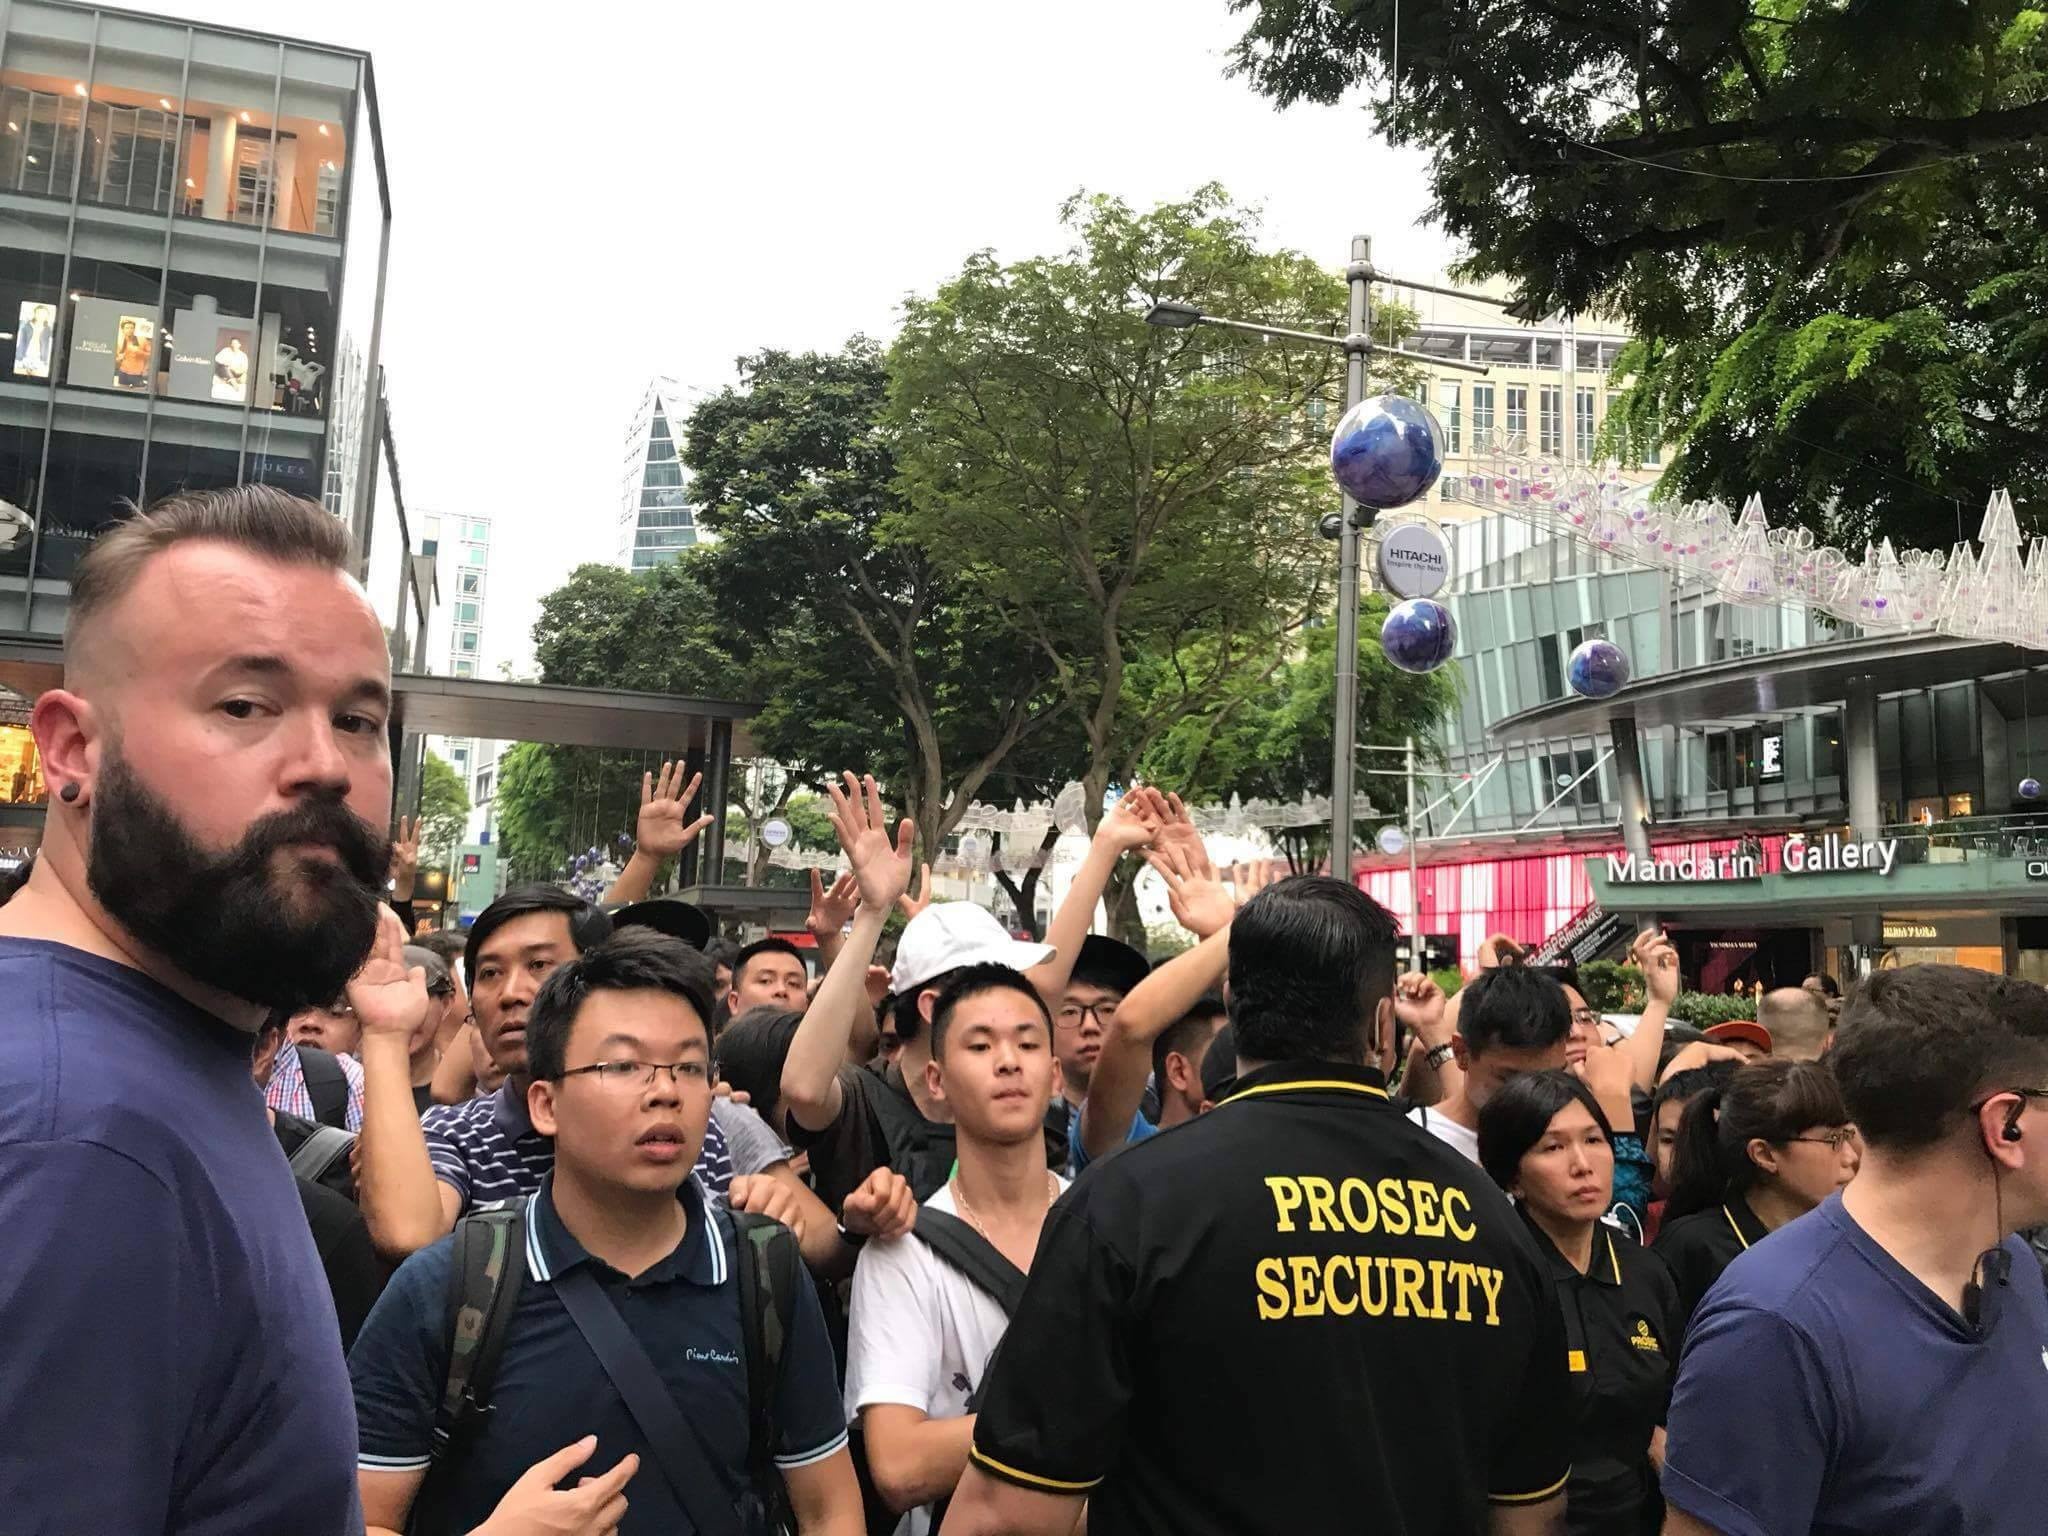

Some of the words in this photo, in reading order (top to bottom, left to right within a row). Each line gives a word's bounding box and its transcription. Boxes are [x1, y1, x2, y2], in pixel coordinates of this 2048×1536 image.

[1386, 559, 1413, 569] Inspire
[1414, 561, 1426, 570] the
[1390, 548, 1442, 564] HITACHI
[1607, 849, 1755, 883] Mandarin
[1783, 833, 1898, 876] Gallery
[1263, 1176, 1478, 1242] PROSEC
[1255, 1254, 1504, 1327] SECURITY
